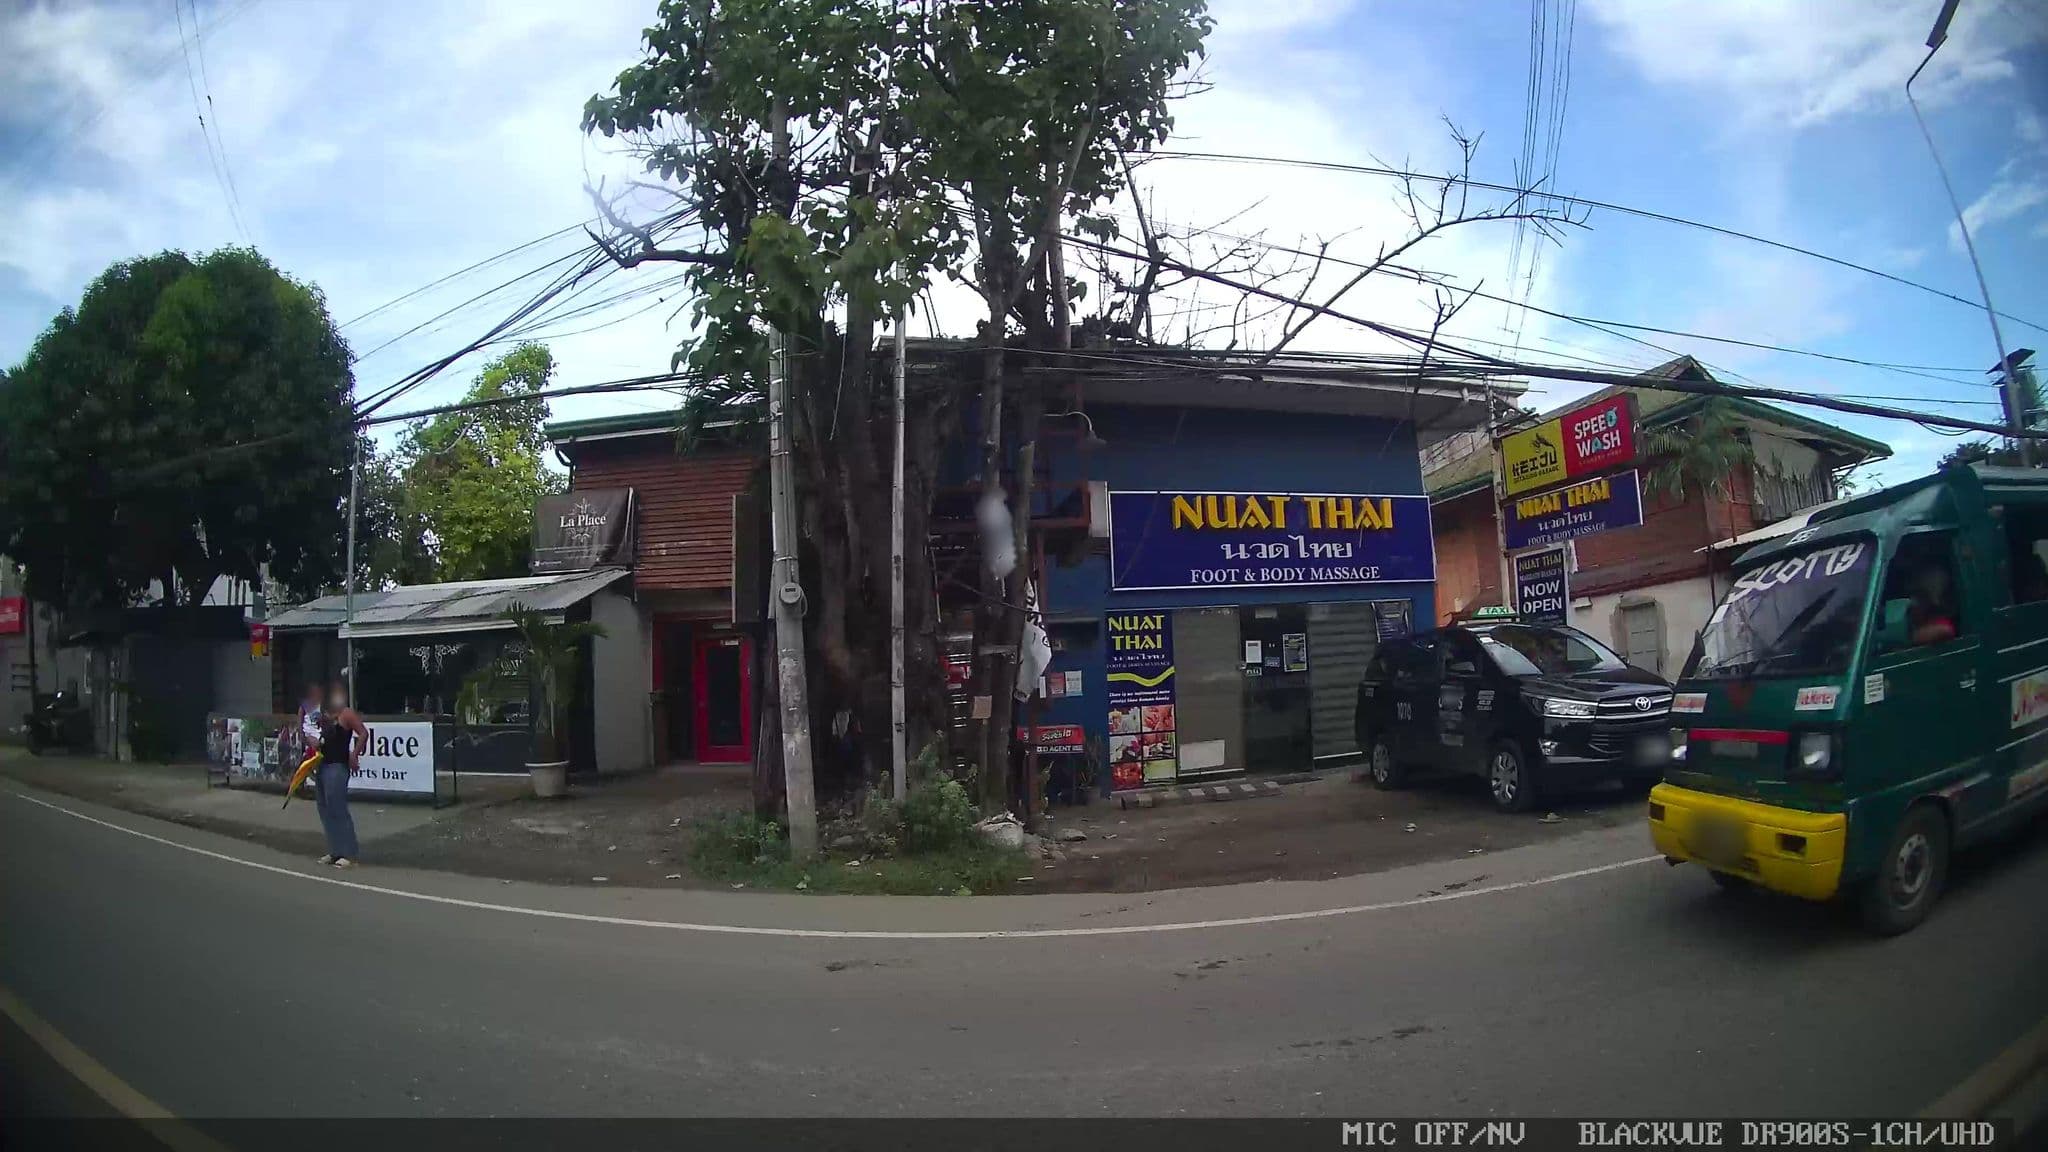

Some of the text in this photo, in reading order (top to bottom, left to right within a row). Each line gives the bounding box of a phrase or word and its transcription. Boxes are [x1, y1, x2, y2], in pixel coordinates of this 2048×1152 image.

[1576, 430, 1621, 458] WASH
[1517, 479, 1610, 520] NUAT THAI
[560, 514, 607, 528] La Place
[1173, 495, 1393, 530] NUAT THAI
[1528, 535, 1546, 546] FOOT
[1553, 530, 1572, 541] BODY
[1573, 523, 1605, 537] MASSAGE
[1221, 535, 1353, 560] นวดไทย
[1519, 551, 1562, 572] NUAT THAI
[1190, 566, 1381, 583] FOOT & BODY MASSAGE
[1726, 543, 1866, 604] SCOTTY
[1523, 580, 1561, 598] NOW
[1522, 597, 1562, 614] OPEN
[1108, 615, 1165, 631] NUAT
[1111, 634, 1162, 650] THAI
[1049, 745, 1071, 753] AGENT
[382, 768, 408, 781] bar
